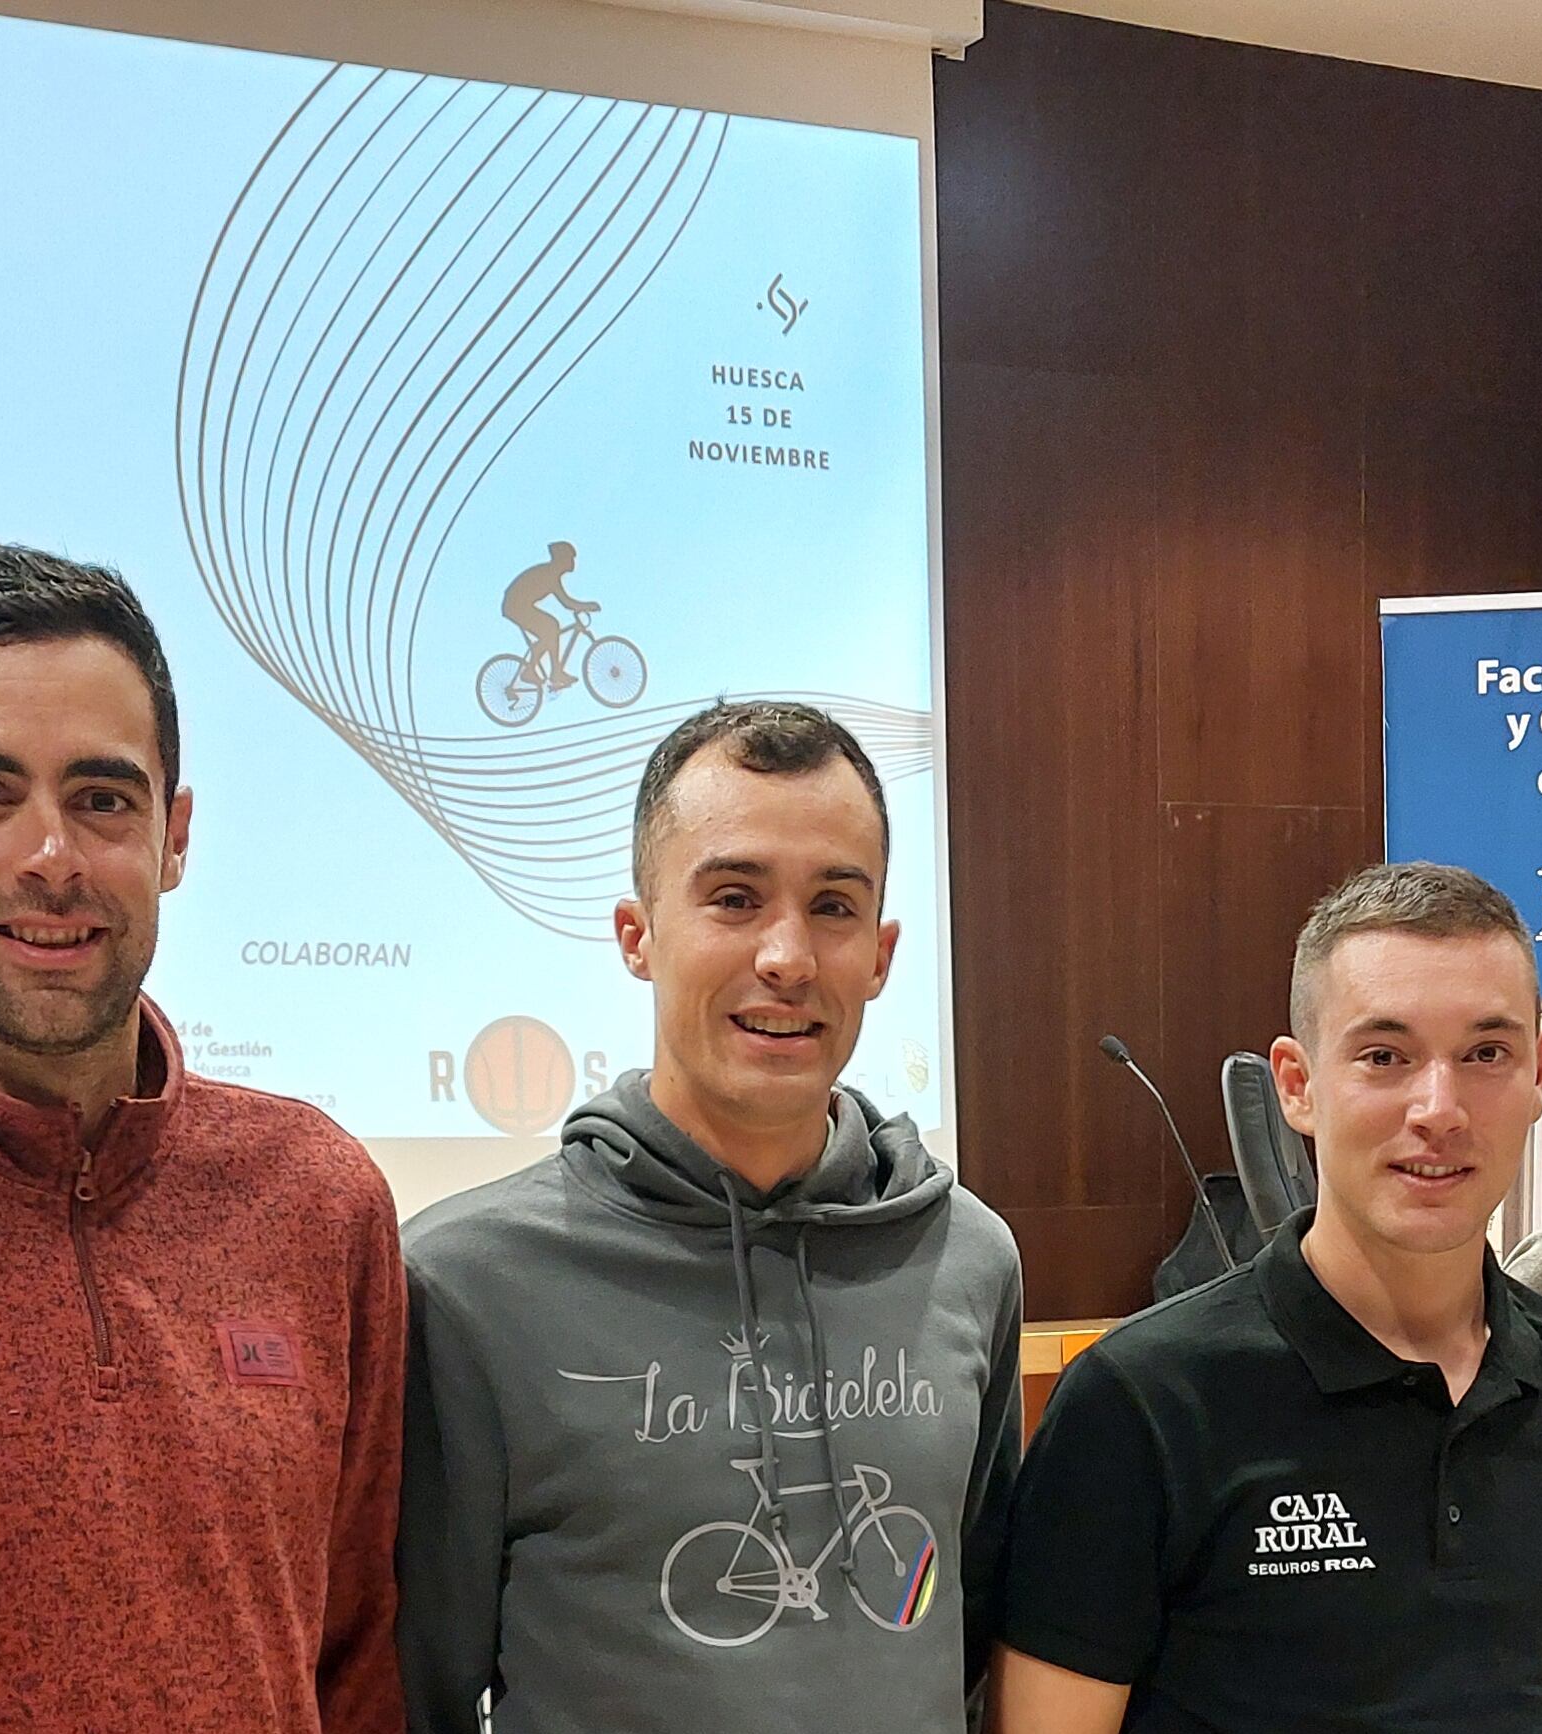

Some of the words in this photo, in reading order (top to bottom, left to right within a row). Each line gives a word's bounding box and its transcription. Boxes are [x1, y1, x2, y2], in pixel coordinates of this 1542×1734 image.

[711, 364, 806, 392] HUESCA
[726, 404, 754, 427] 15
[762, 406, 793, 429] DE
[688, 440, 831, 471] NOVIEMBRE
[1506, 712, 1530, 749] y
[240, 940, 412, 969] COLABORAN
[191, 1022, 213, 1037] de
[207, 1041, 273, 1057] Gestión
[557, 1361, 708, 1443] La
[728, 1346, 944, 1438] Bicicleta
[1270, 1493, 1350, 1522] CAJA
[1255, 1522, 1367, 1553] RURAL
[1248, 1560, 1320, 1576] SEGUROS
[1324, 1556, 1376, 1572] RGA
